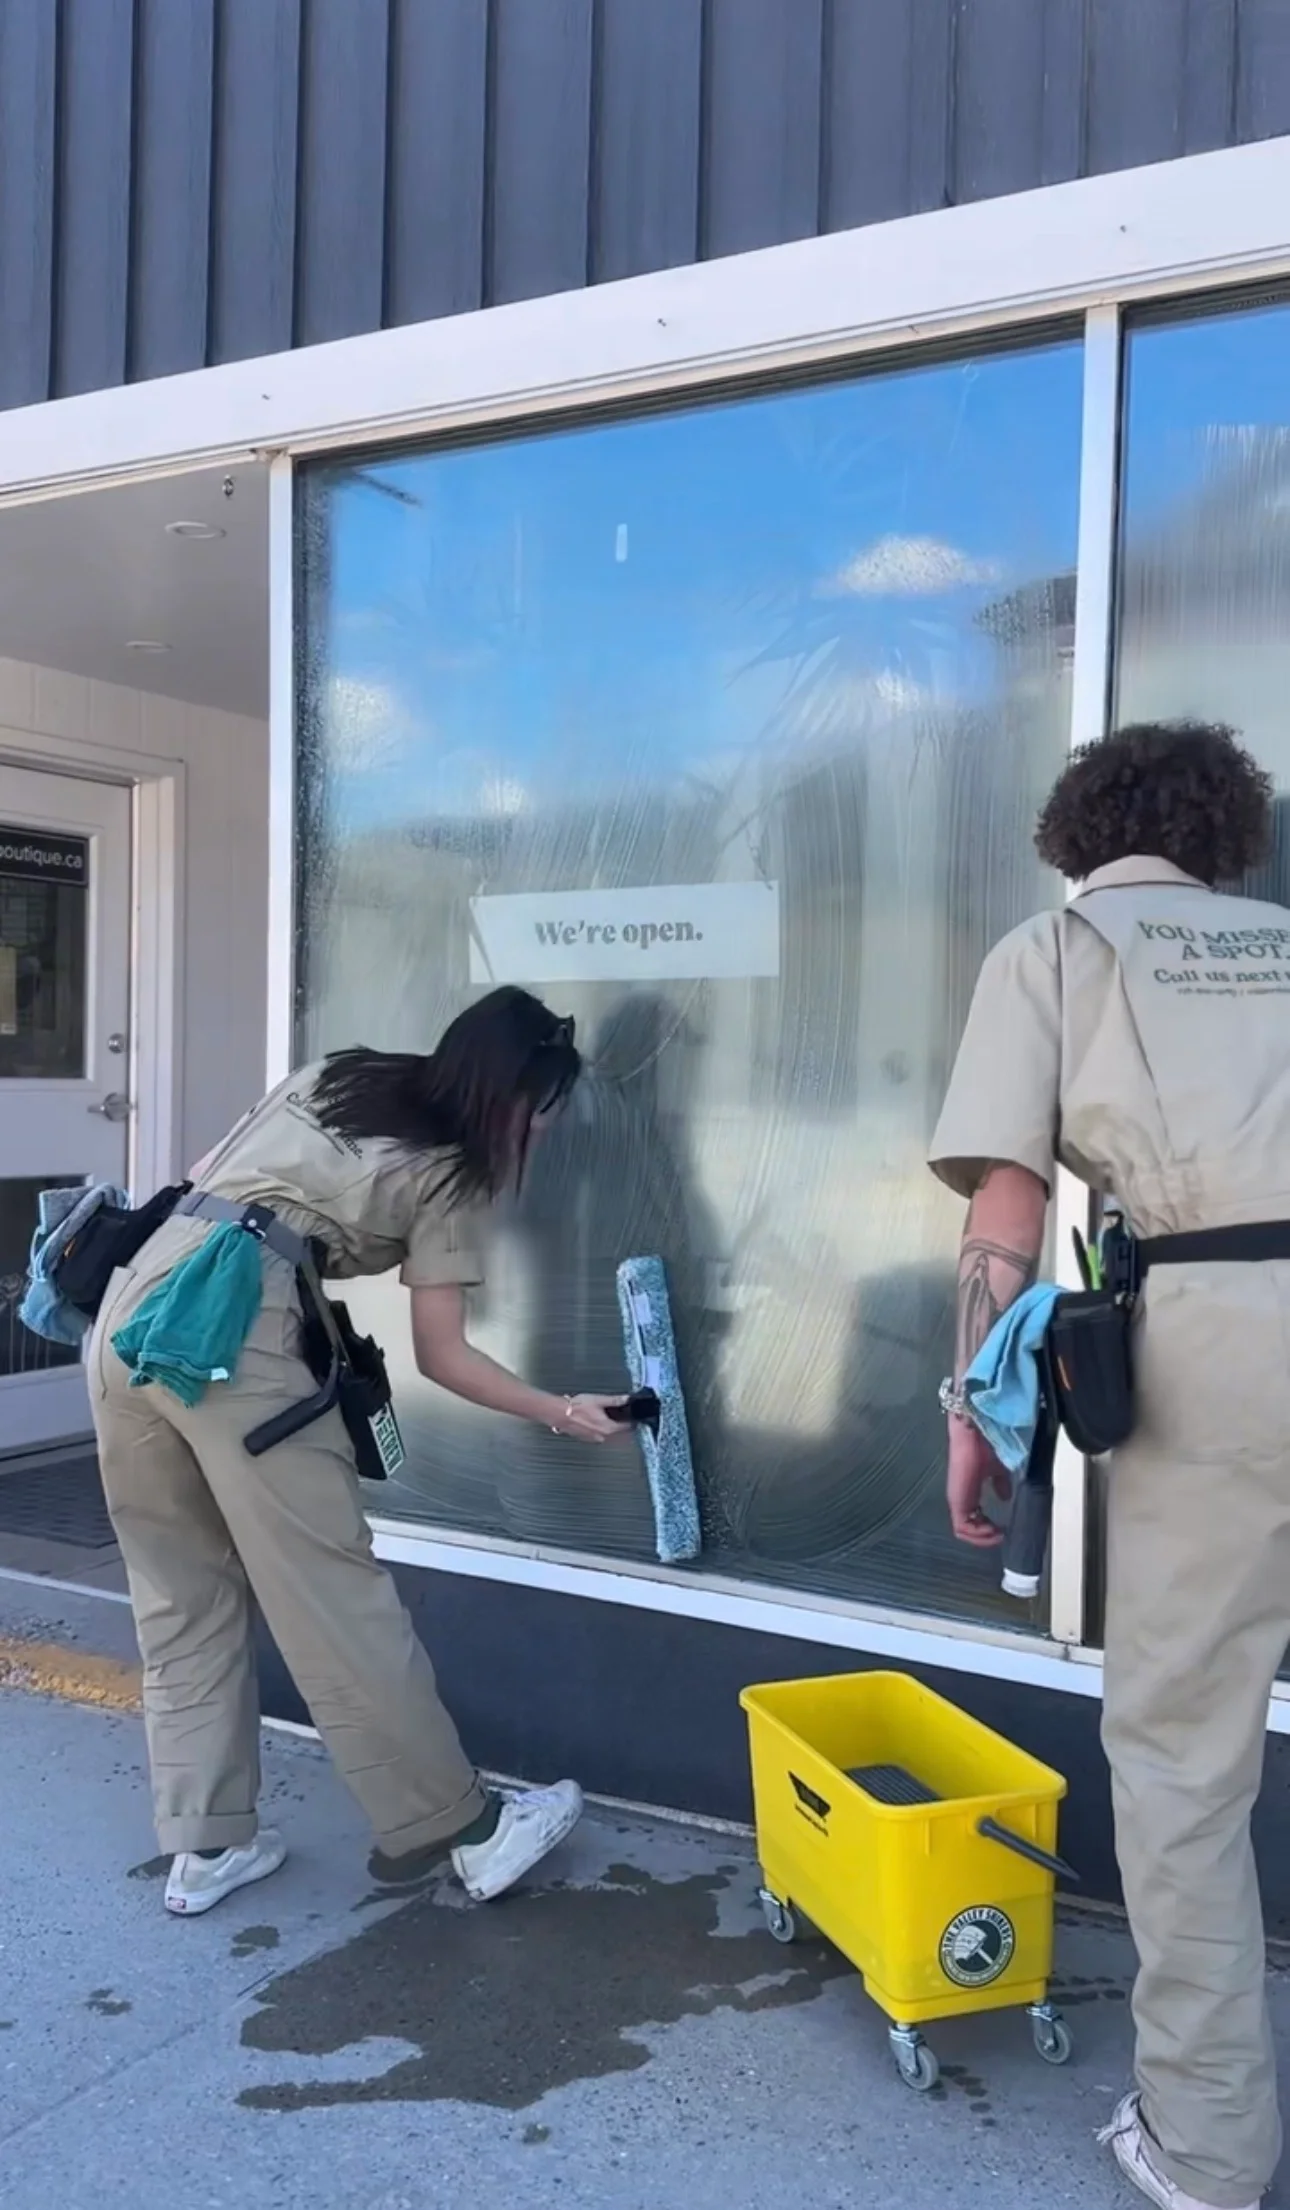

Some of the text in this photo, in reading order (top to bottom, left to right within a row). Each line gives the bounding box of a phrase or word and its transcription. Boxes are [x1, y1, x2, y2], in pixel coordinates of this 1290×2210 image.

[0, 845, 83, 869] outique.ca
[534, 919, 703, 950] We're open.
[1137, 919, 1196, 942] YOU
[1182, 943, 1203, 961] A
[1153, 968, 1200, 984] Call
[1204, 970, 1231, 983] us
[1234, 969, 1281, 983] next
